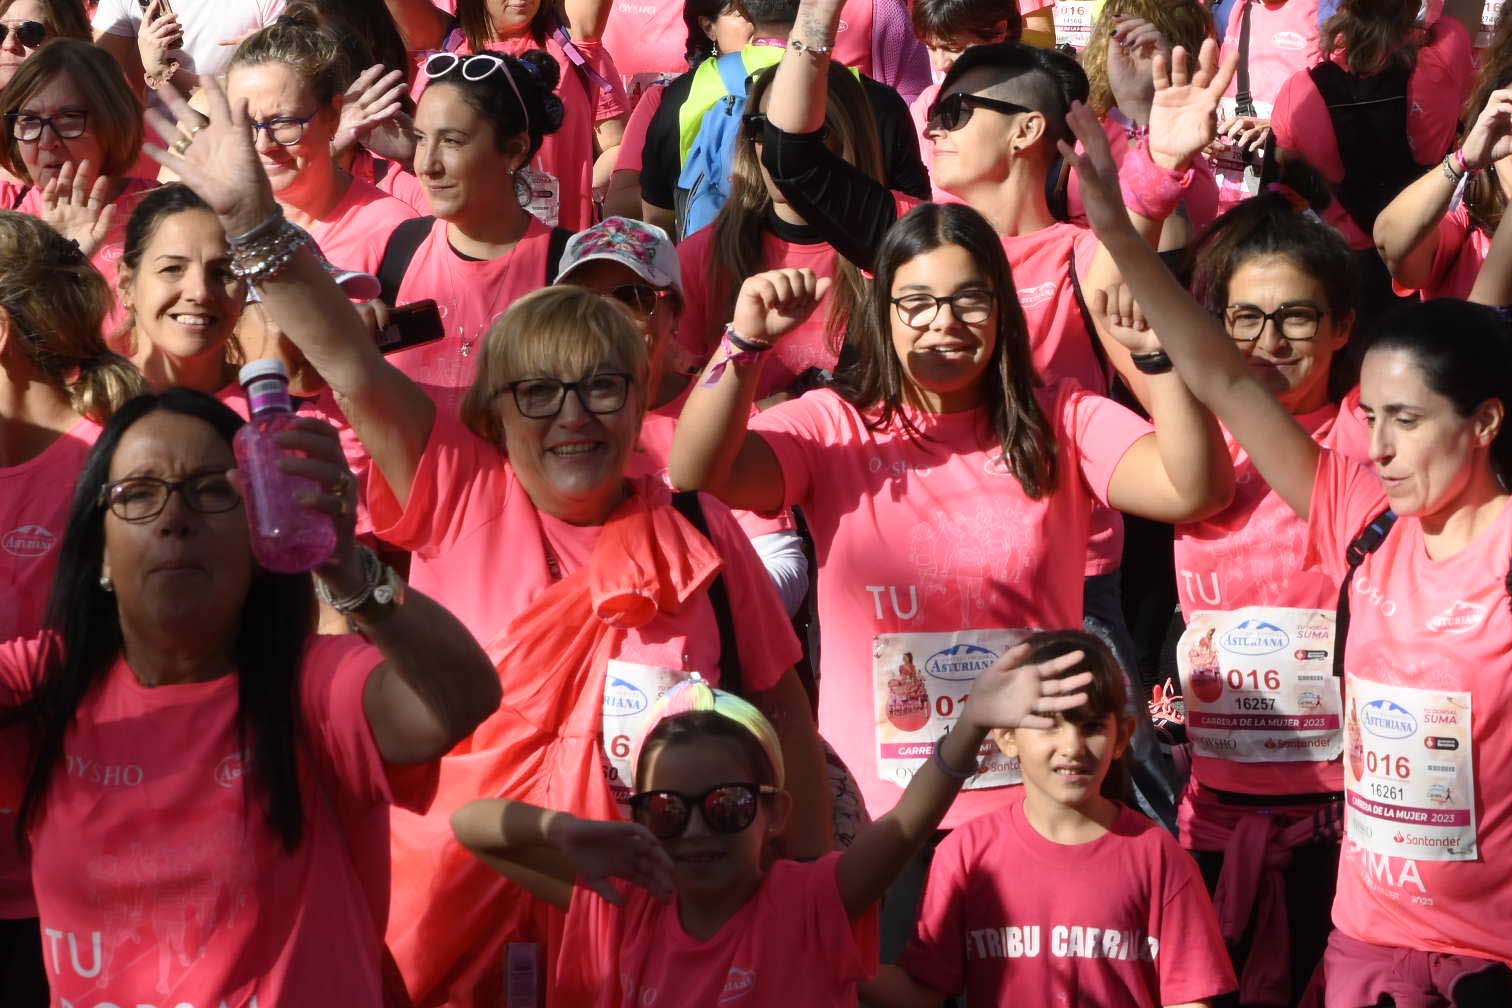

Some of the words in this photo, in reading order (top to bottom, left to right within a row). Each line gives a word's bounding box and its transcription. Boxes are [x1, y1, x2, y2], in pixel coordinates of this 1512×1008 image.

[1181, 569, 1222, 605] TU
[866, 584, 919, 620] TU
[1296, 630, 1329, 639] SUMA
[1227, 669, 1281, 690] 016
[1235, 697, 1276, 711] 16257
[1239, 717, 1254, 727] DE
[1268, 718, 1300, 727] MUJER
[1303, 718, 1326, 727] 2023
[1424, 713, 1458, 725] SUMA
[1366, 750, 1411, 779] 016
[1370, 783, 1404, 801] 16261
[1384, 807, 1395, 818] LA
[1396, 809, 1428, 822] MUJER
[1431, 813, 1455, 823] 2023
[1406, 835, 1461, 847] Santander
[46, 928, 101, 978] TU
